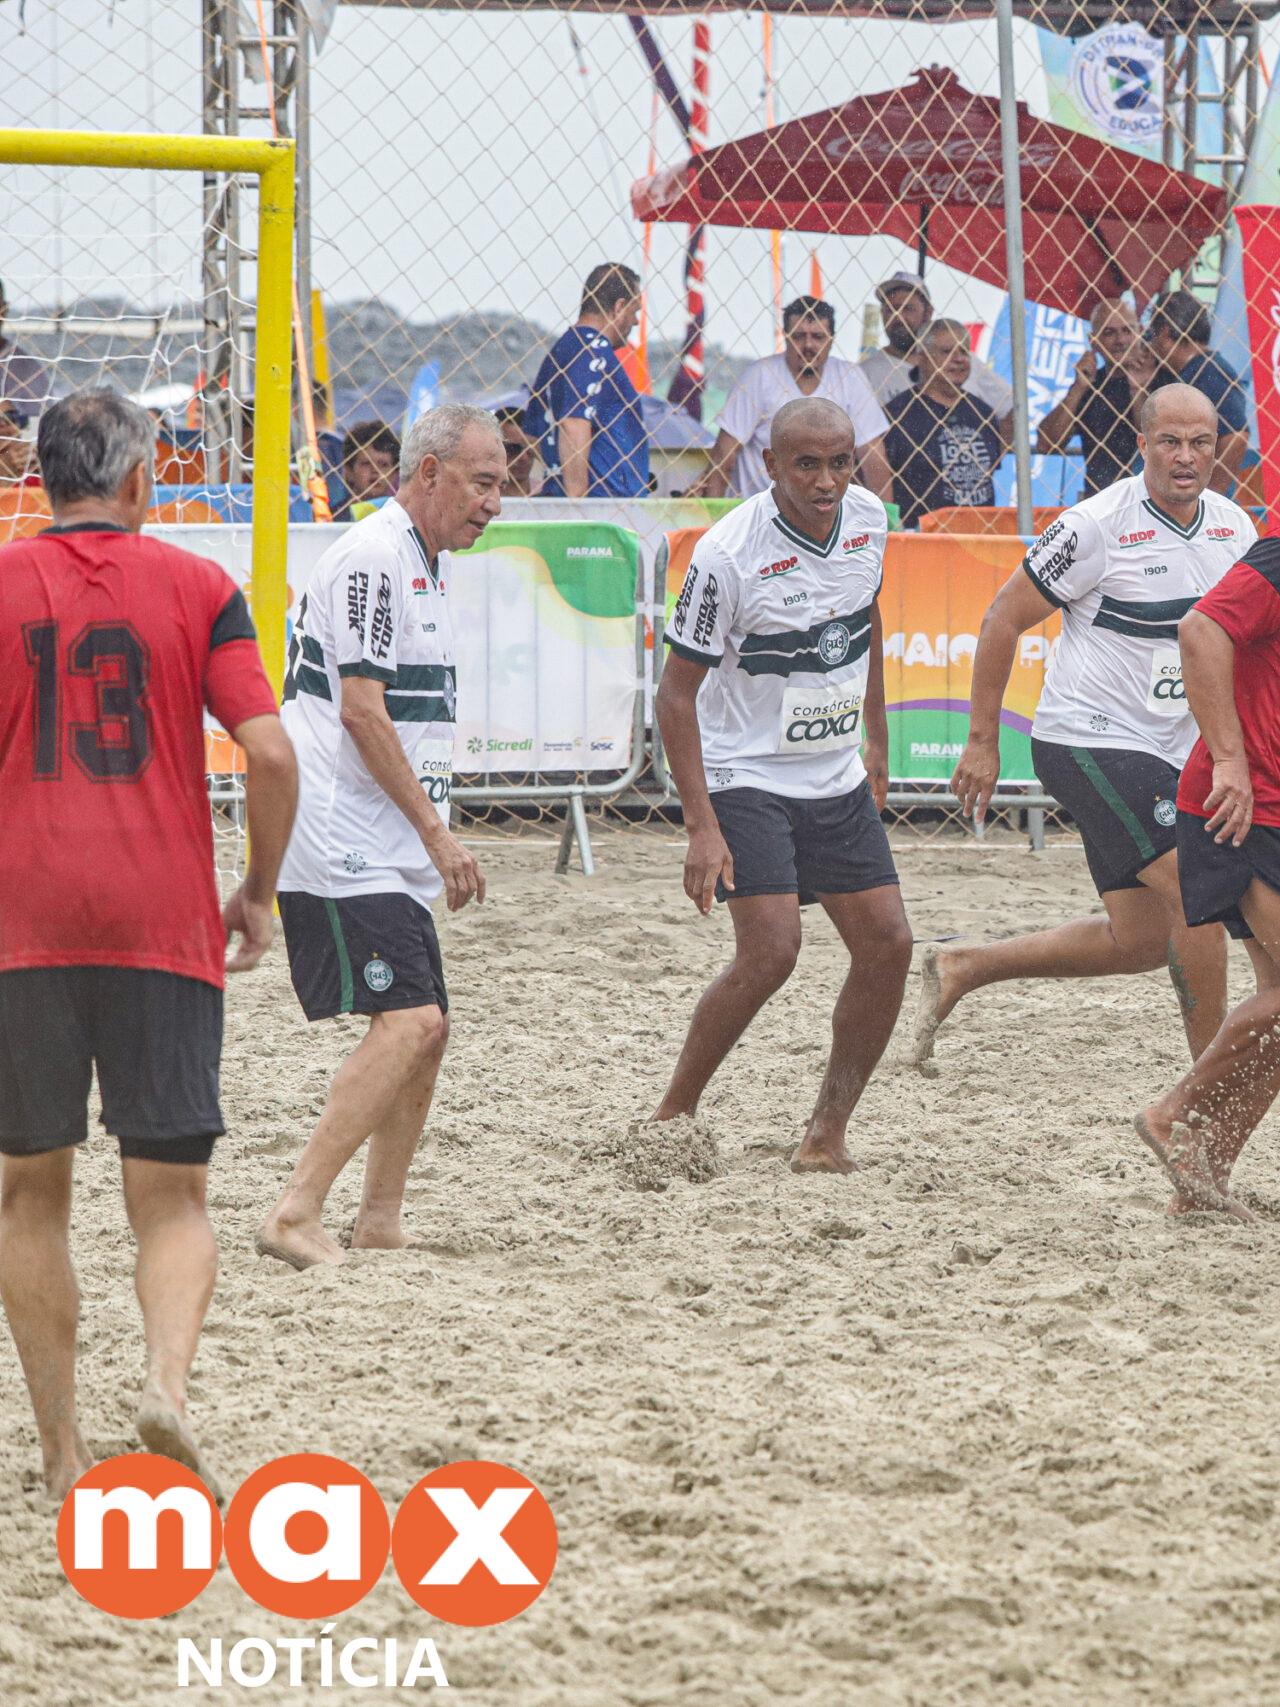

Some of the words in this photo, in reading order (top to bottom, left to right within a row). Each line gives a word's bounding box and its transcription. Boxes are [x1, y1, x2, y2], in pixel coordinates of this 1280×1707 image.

[851, 533, 870, 549] RDP
[1129, 529, 1156, 543] RDP
[771, 556, 798, 573] RDP
[1038, 553, 1062, 580] PRO
[1041, 553, 1077, 587] TORK
[1144, 565, 1168, 576] 1909
[783, 591, 808, 607] 1909
[693, 603, 709, 642] PRO
[701, 602, 720, 648] TORK
[21, 619, 156, 784] 13
[792, 695, 860, 716] consórcio
[486, 738, 533, 752] Sicredi
